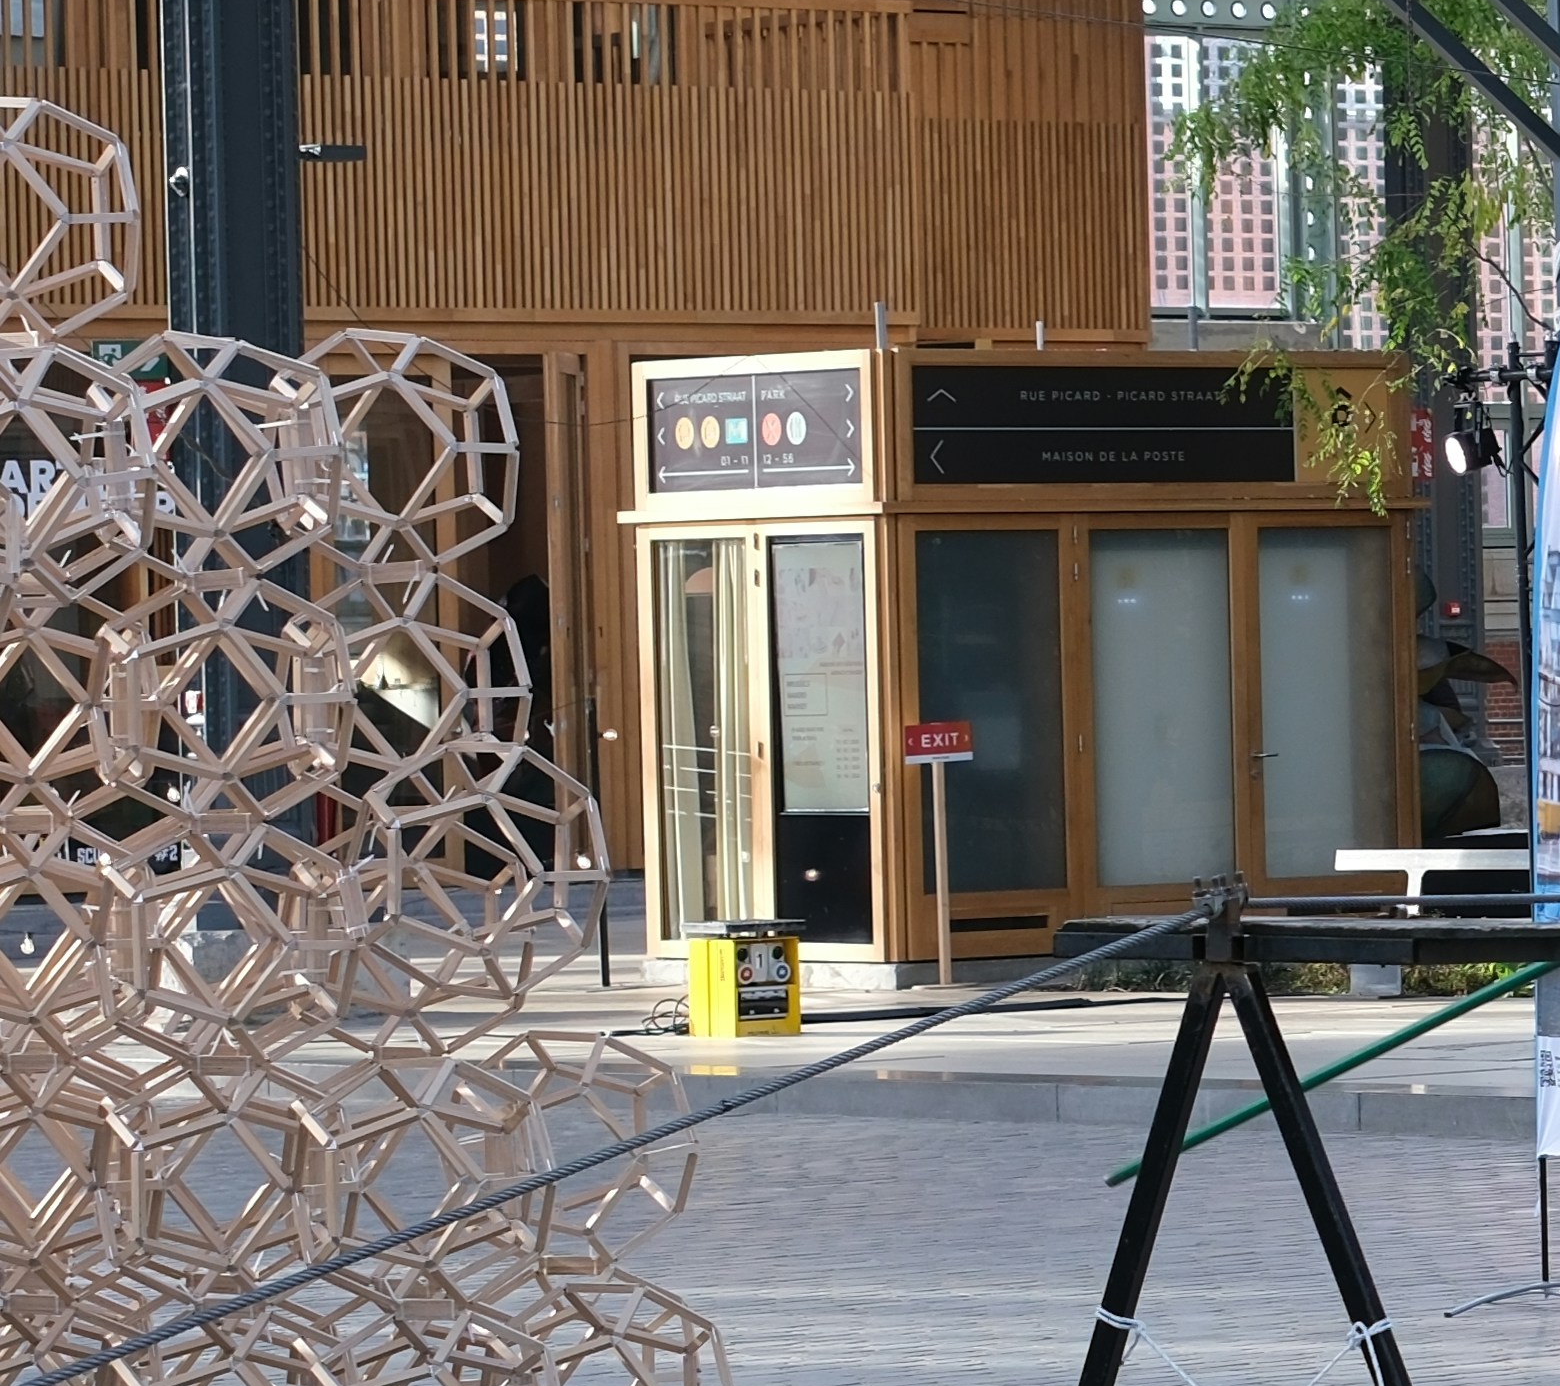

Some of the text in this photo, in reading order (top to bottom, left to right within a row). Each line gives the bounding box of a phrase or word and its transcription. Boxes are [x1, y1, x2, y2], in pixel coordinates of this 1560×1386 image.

[761, 389, 786, 401] PARK
[1020, 390, 1046, 401] RUE
[1052, 390, 1101, 401] PICARD
[1117, 390, 1166, 401] PICARD
[1171, 390, 1222, 401] STRAAT
[1042, 451, 1186, 462] MAISON DE LA POSTE
[921, 732, 960, 748] EXIT
